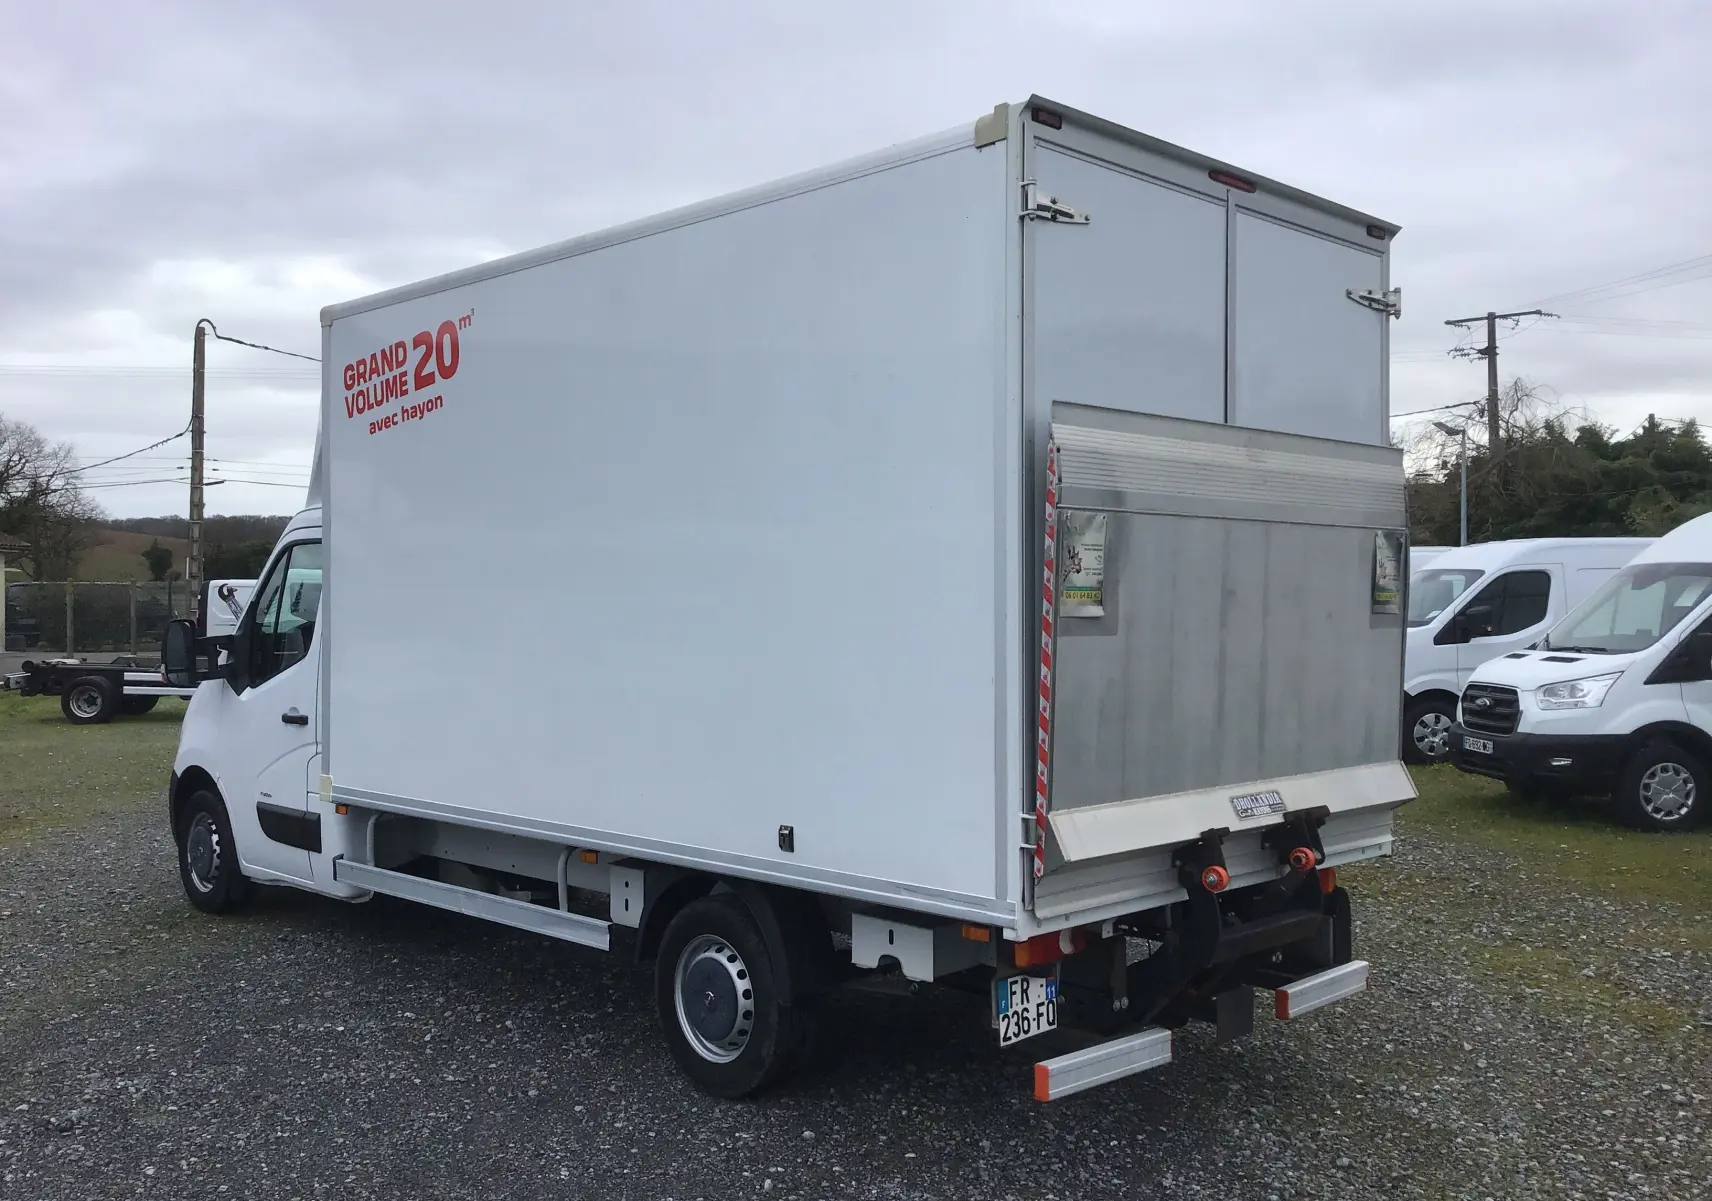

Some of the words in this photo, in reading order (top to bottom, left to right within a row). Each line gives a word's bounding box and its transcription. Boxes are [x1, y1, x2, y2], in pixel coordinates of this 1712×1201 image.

[343, 340, 407, 391] GRAND
[412, 320, 460, 391] 20
[344, 370, 409, 419] VOLUME
[369, 412, 399, 435] avec
[401, 394, 444, 422] hayon
[1233, 791, 1282, 810] DHOLLANDIA
[1046, 985, 1056, 999] 11
[1001, 999, 1056, 1043] 236-FQ
